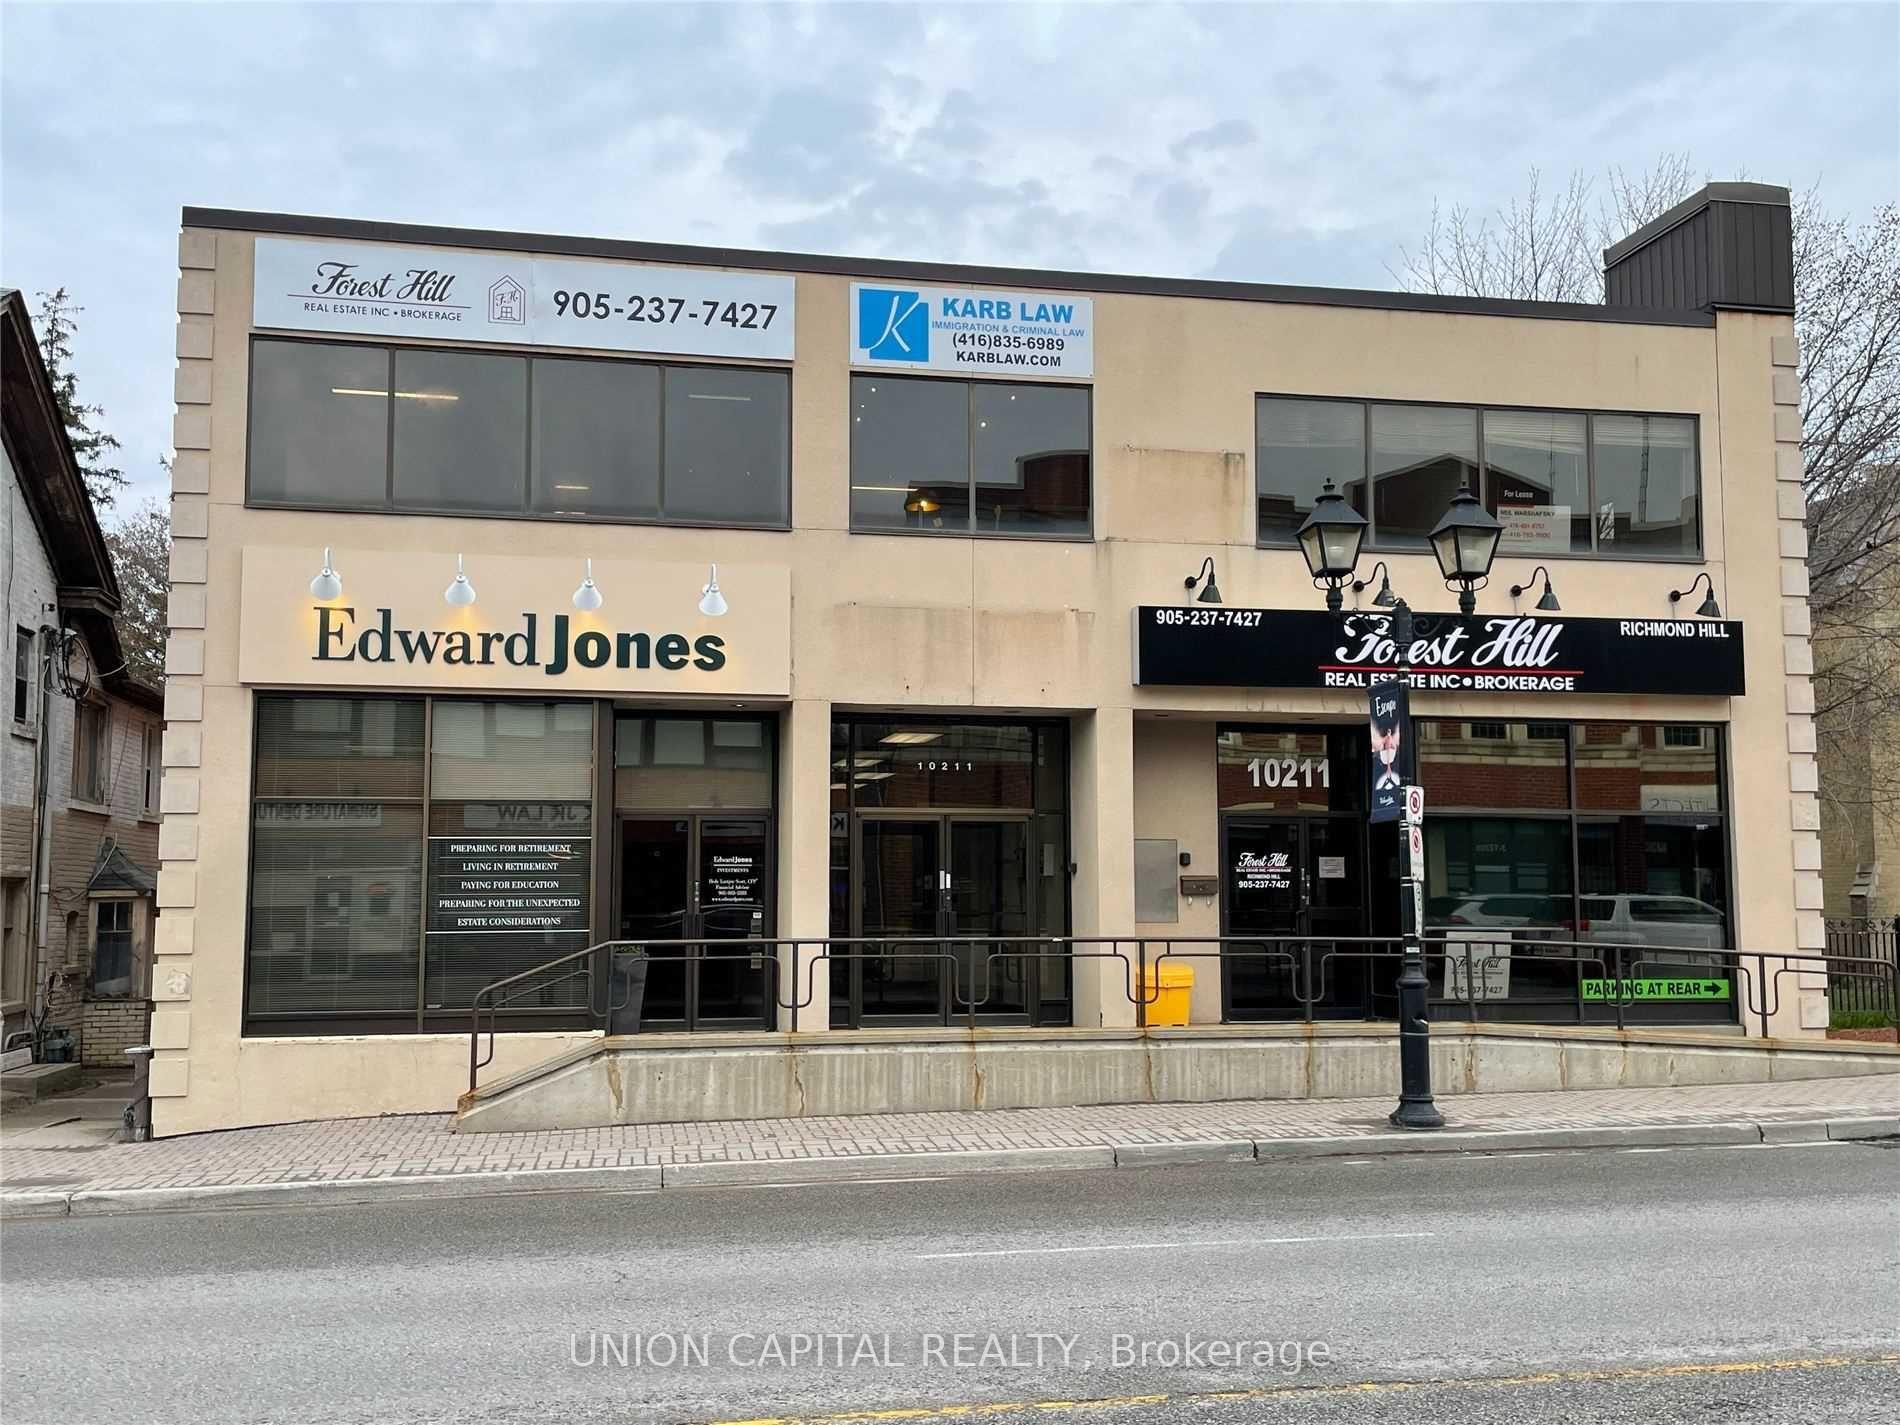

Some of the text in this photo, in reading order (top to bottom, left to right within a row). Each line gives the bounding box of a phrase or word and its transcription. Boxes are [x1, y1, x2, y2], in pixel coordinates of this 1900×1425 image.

[311, 261, 456, 302] Forest Hill
[304, 302, 462, 322] REAL ESTATE INC BROKERAGE
[552, 289, 778, 330] 905-237-7427
[942, 297, 1073, 323] KARB LAW
[932, 321, 1085, 338] IMMIGRATION & CRIMINAL LAW
[952, 332, 1065, 351] (416)835-6989
[956, 351, 1062, 367] KARBLAW.COM
[1155, 609, 1263, 627] 905-237-7427
[1619, 621, 1730, 638] RICHMOND HILL
[1335, 614, 1564, 667] Foest Hill
[1325, 672, 1366, 686] REAL
[1430, 675, 1461, 689] INC
[1477, 676, 1575, 691] BROKERAGE
[1247, 758, 1330, 788] 10211
[450, 844, 572, 853] PREPARING FOR RETIREMENT
[462, 862, 559, 871] LIVING IN RETIREMENT
[1238, 852, 1289, 867] Forest Hill
[461, 880, 560, 889] PAYING FOR EDUCATION
[1238, 880, 1290, 889] 905-237-7427
[439, 898, 581, 908] PREPARING FOR THE UNEXPECTED
[457, 917, 561, 927] ESTATE CONSIDERATIONS
[1647, 982, 1664, 995] AT
[1667, 982, 1702, 995] REAR
